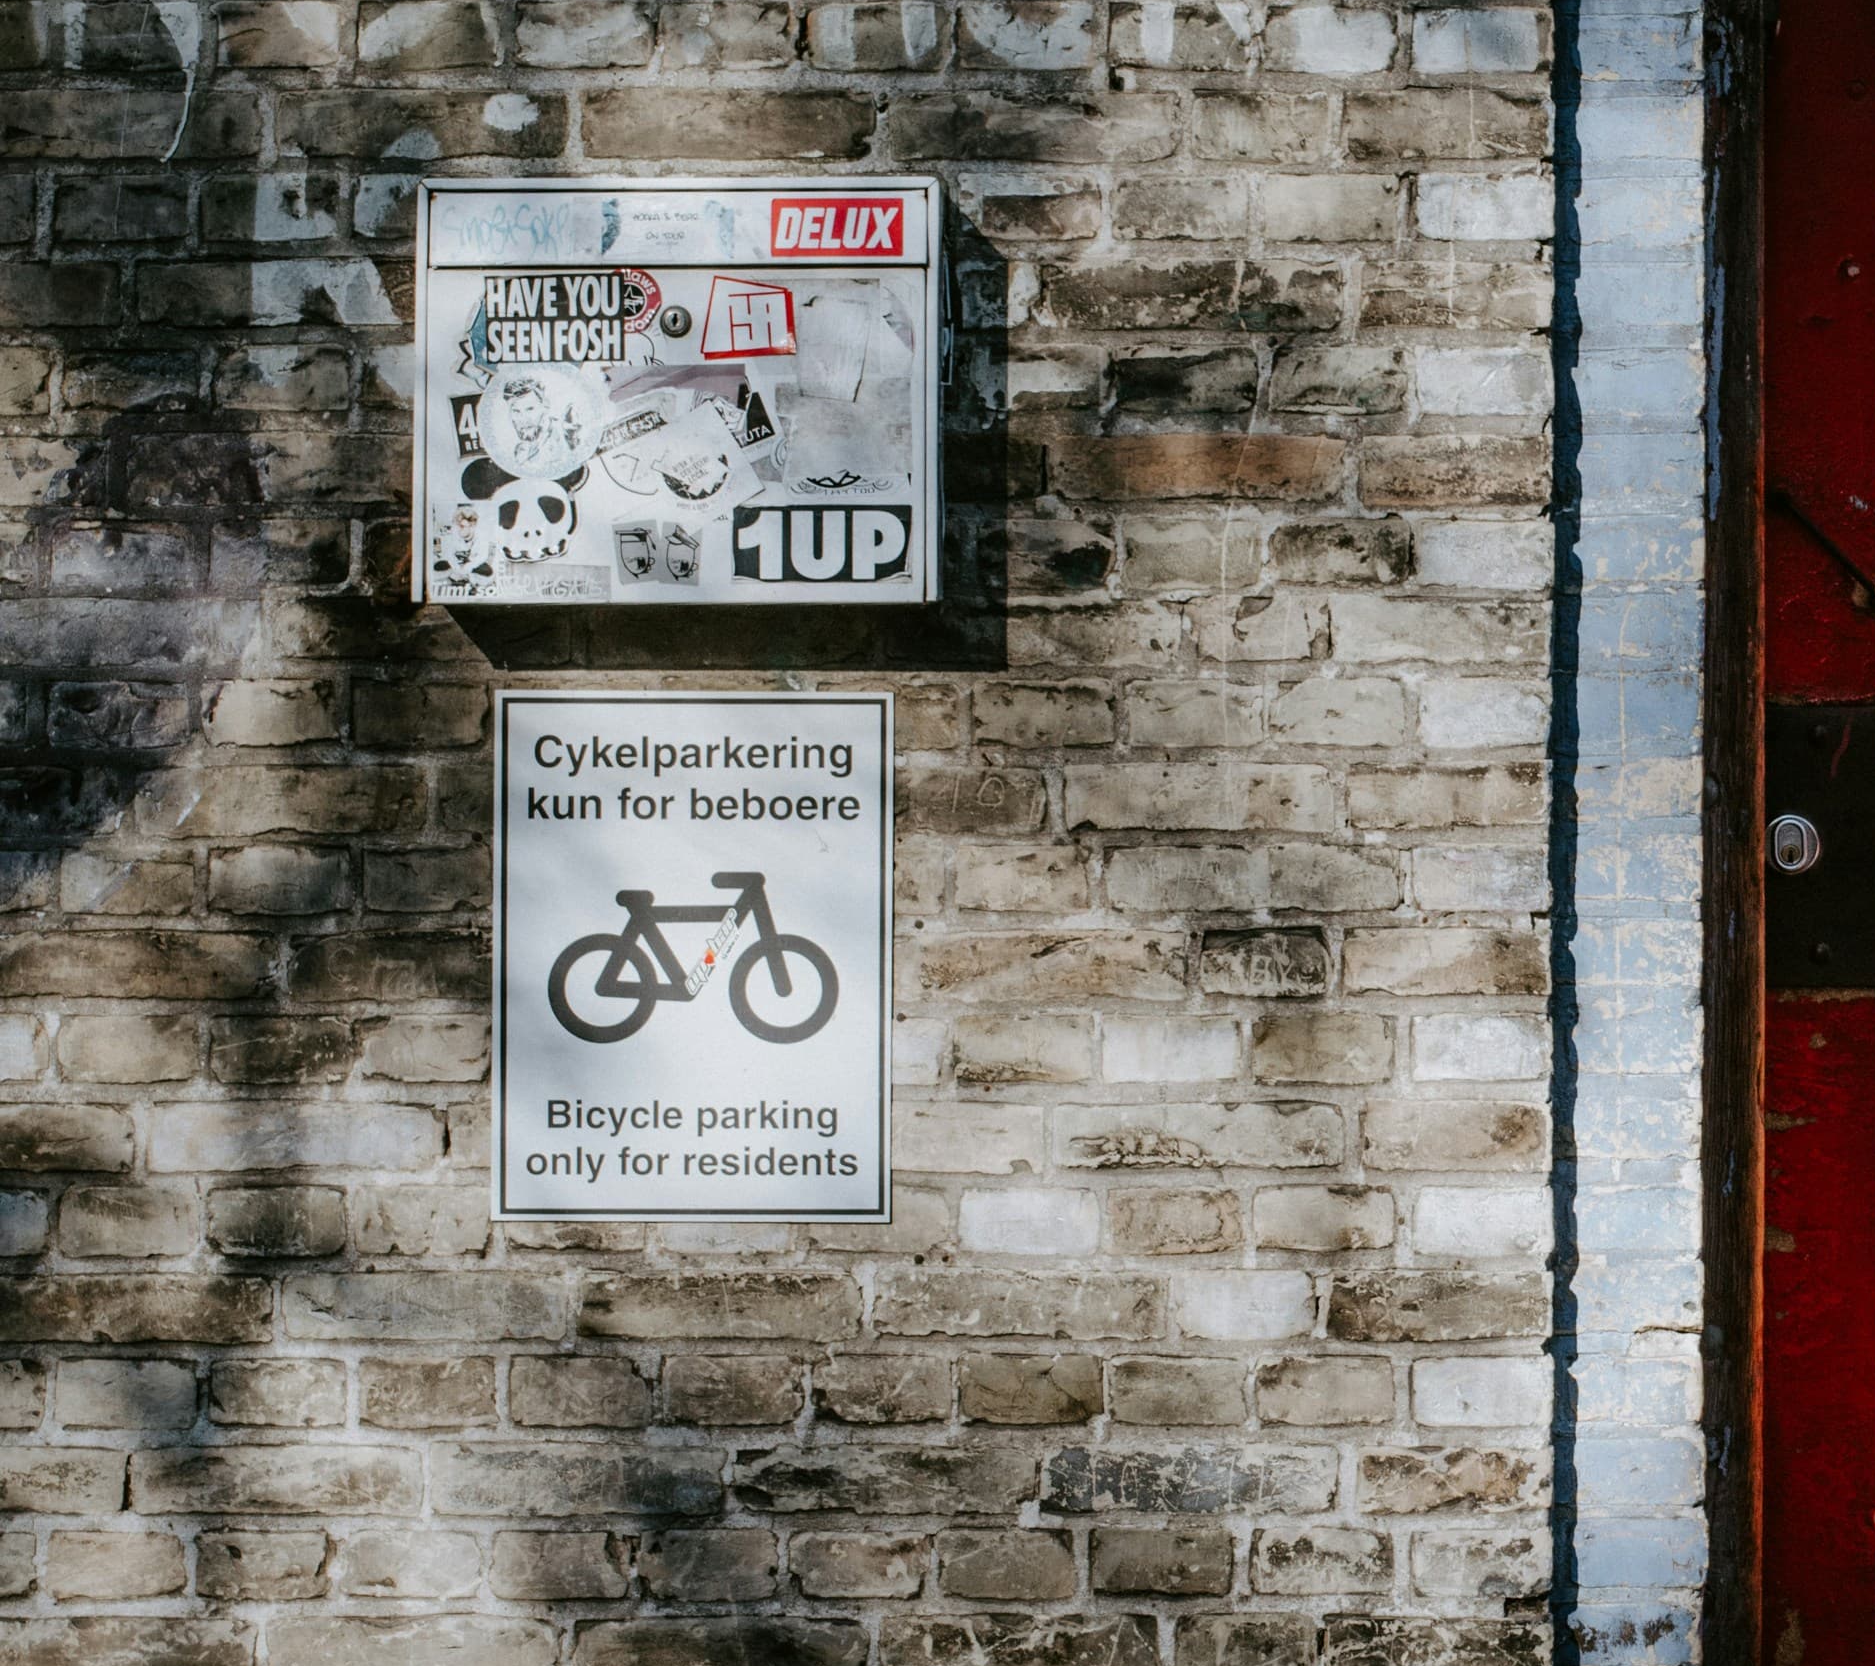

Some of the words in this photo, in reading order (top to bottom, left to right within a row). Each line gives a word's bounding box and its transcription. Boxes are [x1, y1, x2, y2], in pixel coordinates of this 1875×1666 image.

[774, 206, 898, 250] DELUX
[486, 276, 558, 318] HAVE
[562, 274, 621, 317] YOU
[487, 319, 551, 362] SEEN
[554, 318, 621, 362] FOSH
[737, 510, 906, 580] 1UP
[533, 734, 854, 776] Cykelparkering
[527, 787, 602, 821] kun
[618, 787, 675, 821] for
[689, 788, 861, 821] beboere
[547, 1099, 682, 1137] Bicycle
[696, 1100, 839, 1138] parking
[526, 1147, 606, 1183] only
[618, 1146, 670, 1177] for
[683, 1147, 859, 1177] residents
